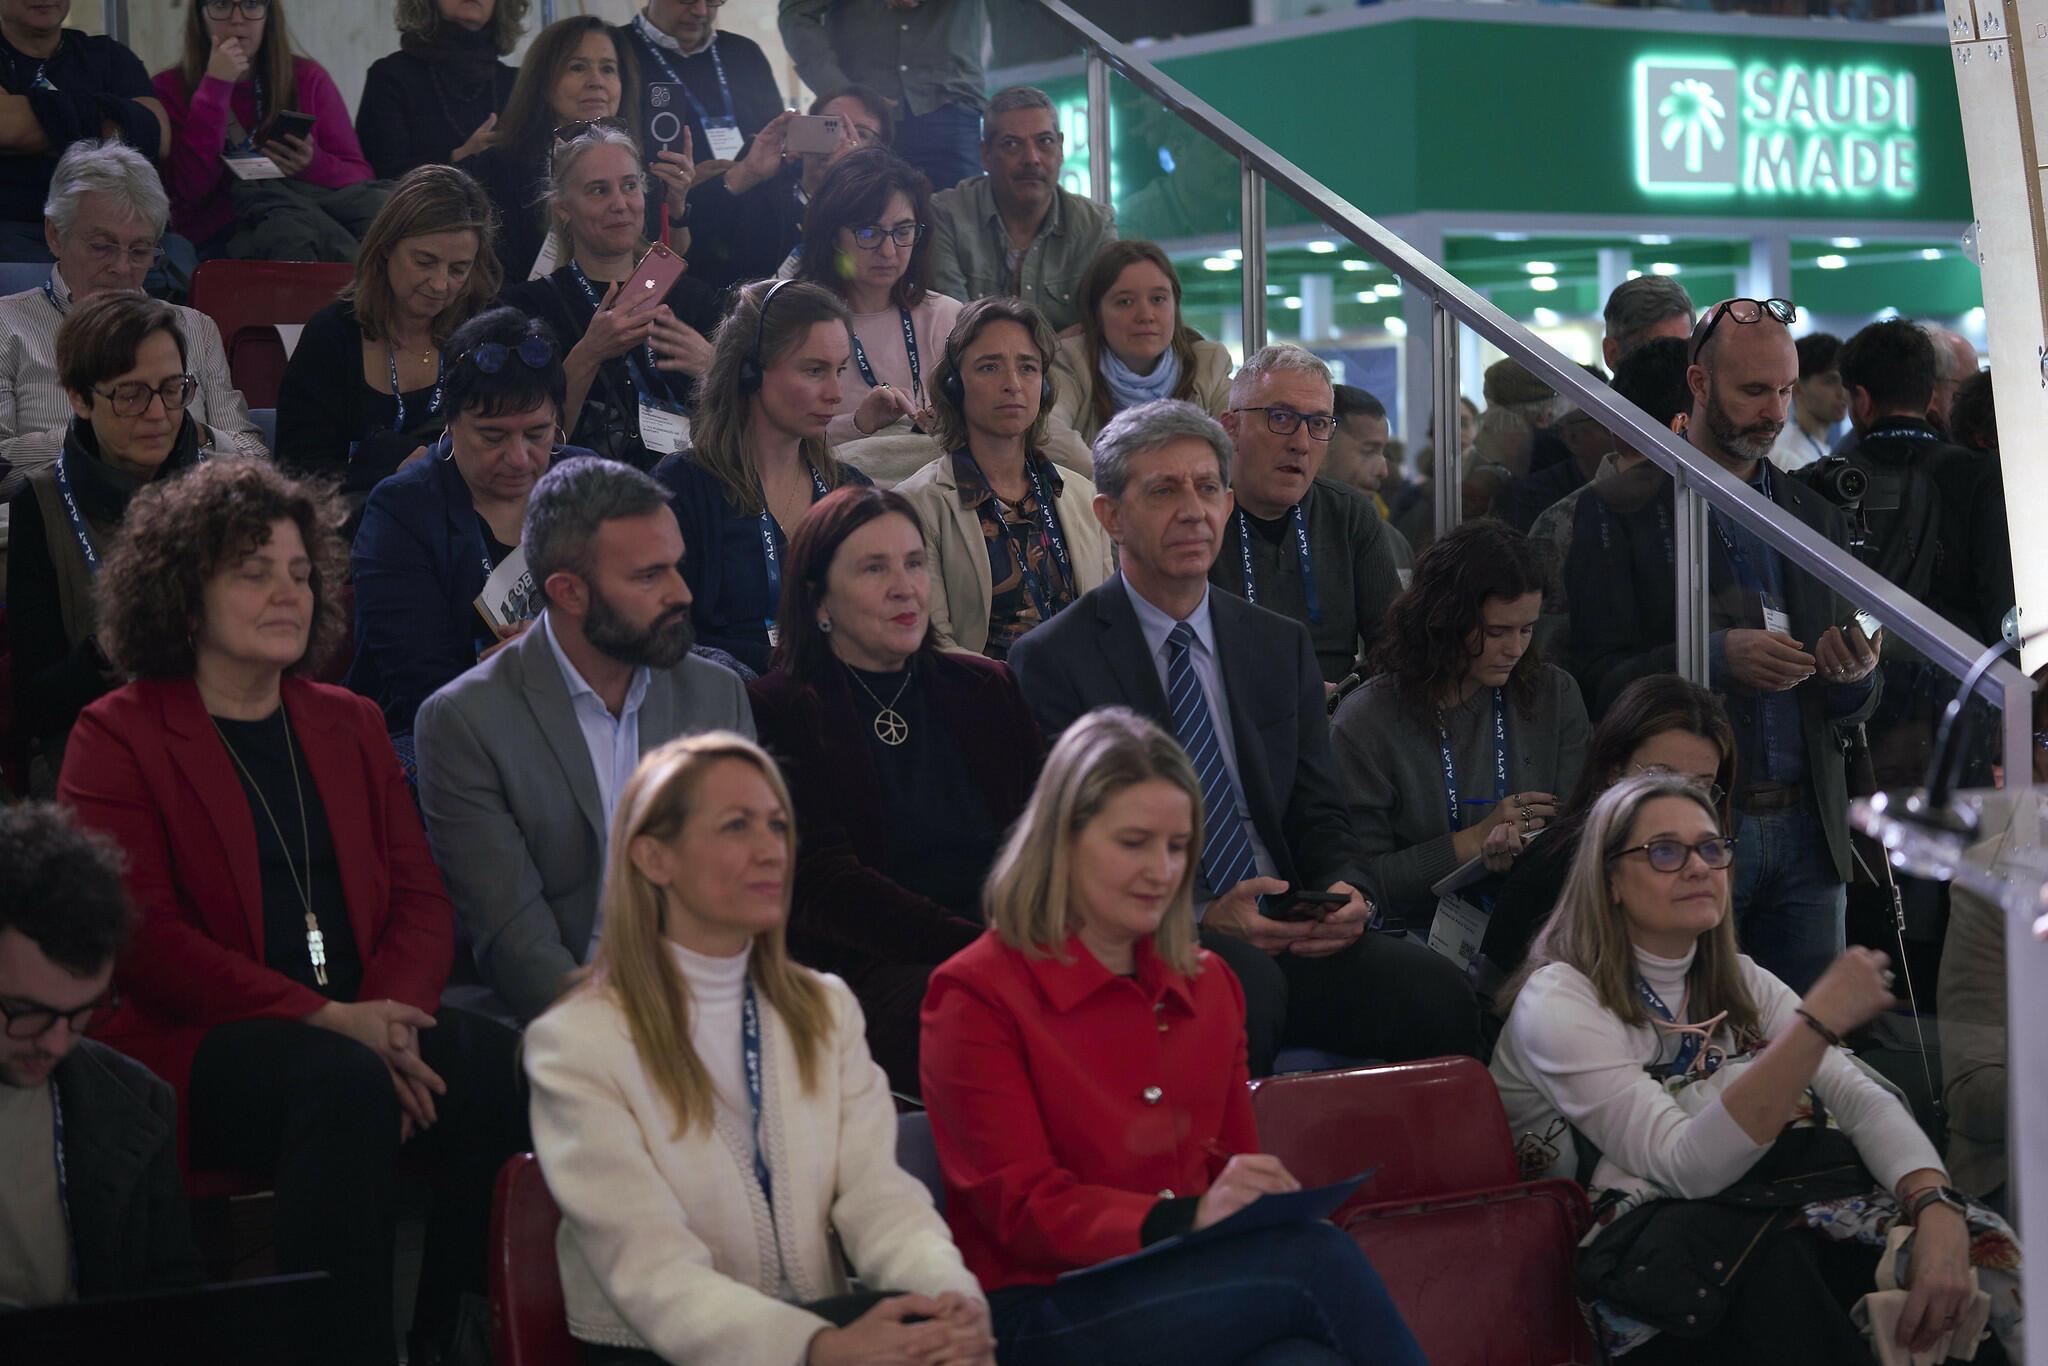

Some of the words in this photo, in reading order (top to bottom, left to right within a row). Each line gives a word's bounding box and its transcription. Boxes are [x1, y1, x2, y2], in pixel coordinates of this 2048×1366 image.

[1744, 65, 1918, 130] SAUDI
[1744, 134, 1918, 194] MADE
[856, 347, 869, 371] ALAT
[903, 320, 913, 343] ALAT
[909, 351, 918, 374] ALAT
[811, 467, 828, 495] ALAT
[63, 492, 80, 521] ALAT
[79, 531, 96, 561] ALAT
[760, 504, 768, 521] AL
[1031, 472, 1043, 497] ALAT
[1040, 503, 1054, 529] ALAT
[1051, 537, 1066, 564] ALAT
[1240, 511, 1249, 539] ALAT
[763, 530, 776, 561] ALAT
[1298, 528, 1309, 556] ALAT
[1243, 546, 1252, 574] ALAT
[1247, 582, 1255, 604] ALA
[1496, 710, 1504, 740] ALAT
[1497, 749, 1505, 780] ALAT
[1442, 747, 1454, 779] ALAT
[1448, 788, 1459, 819] ALAT
